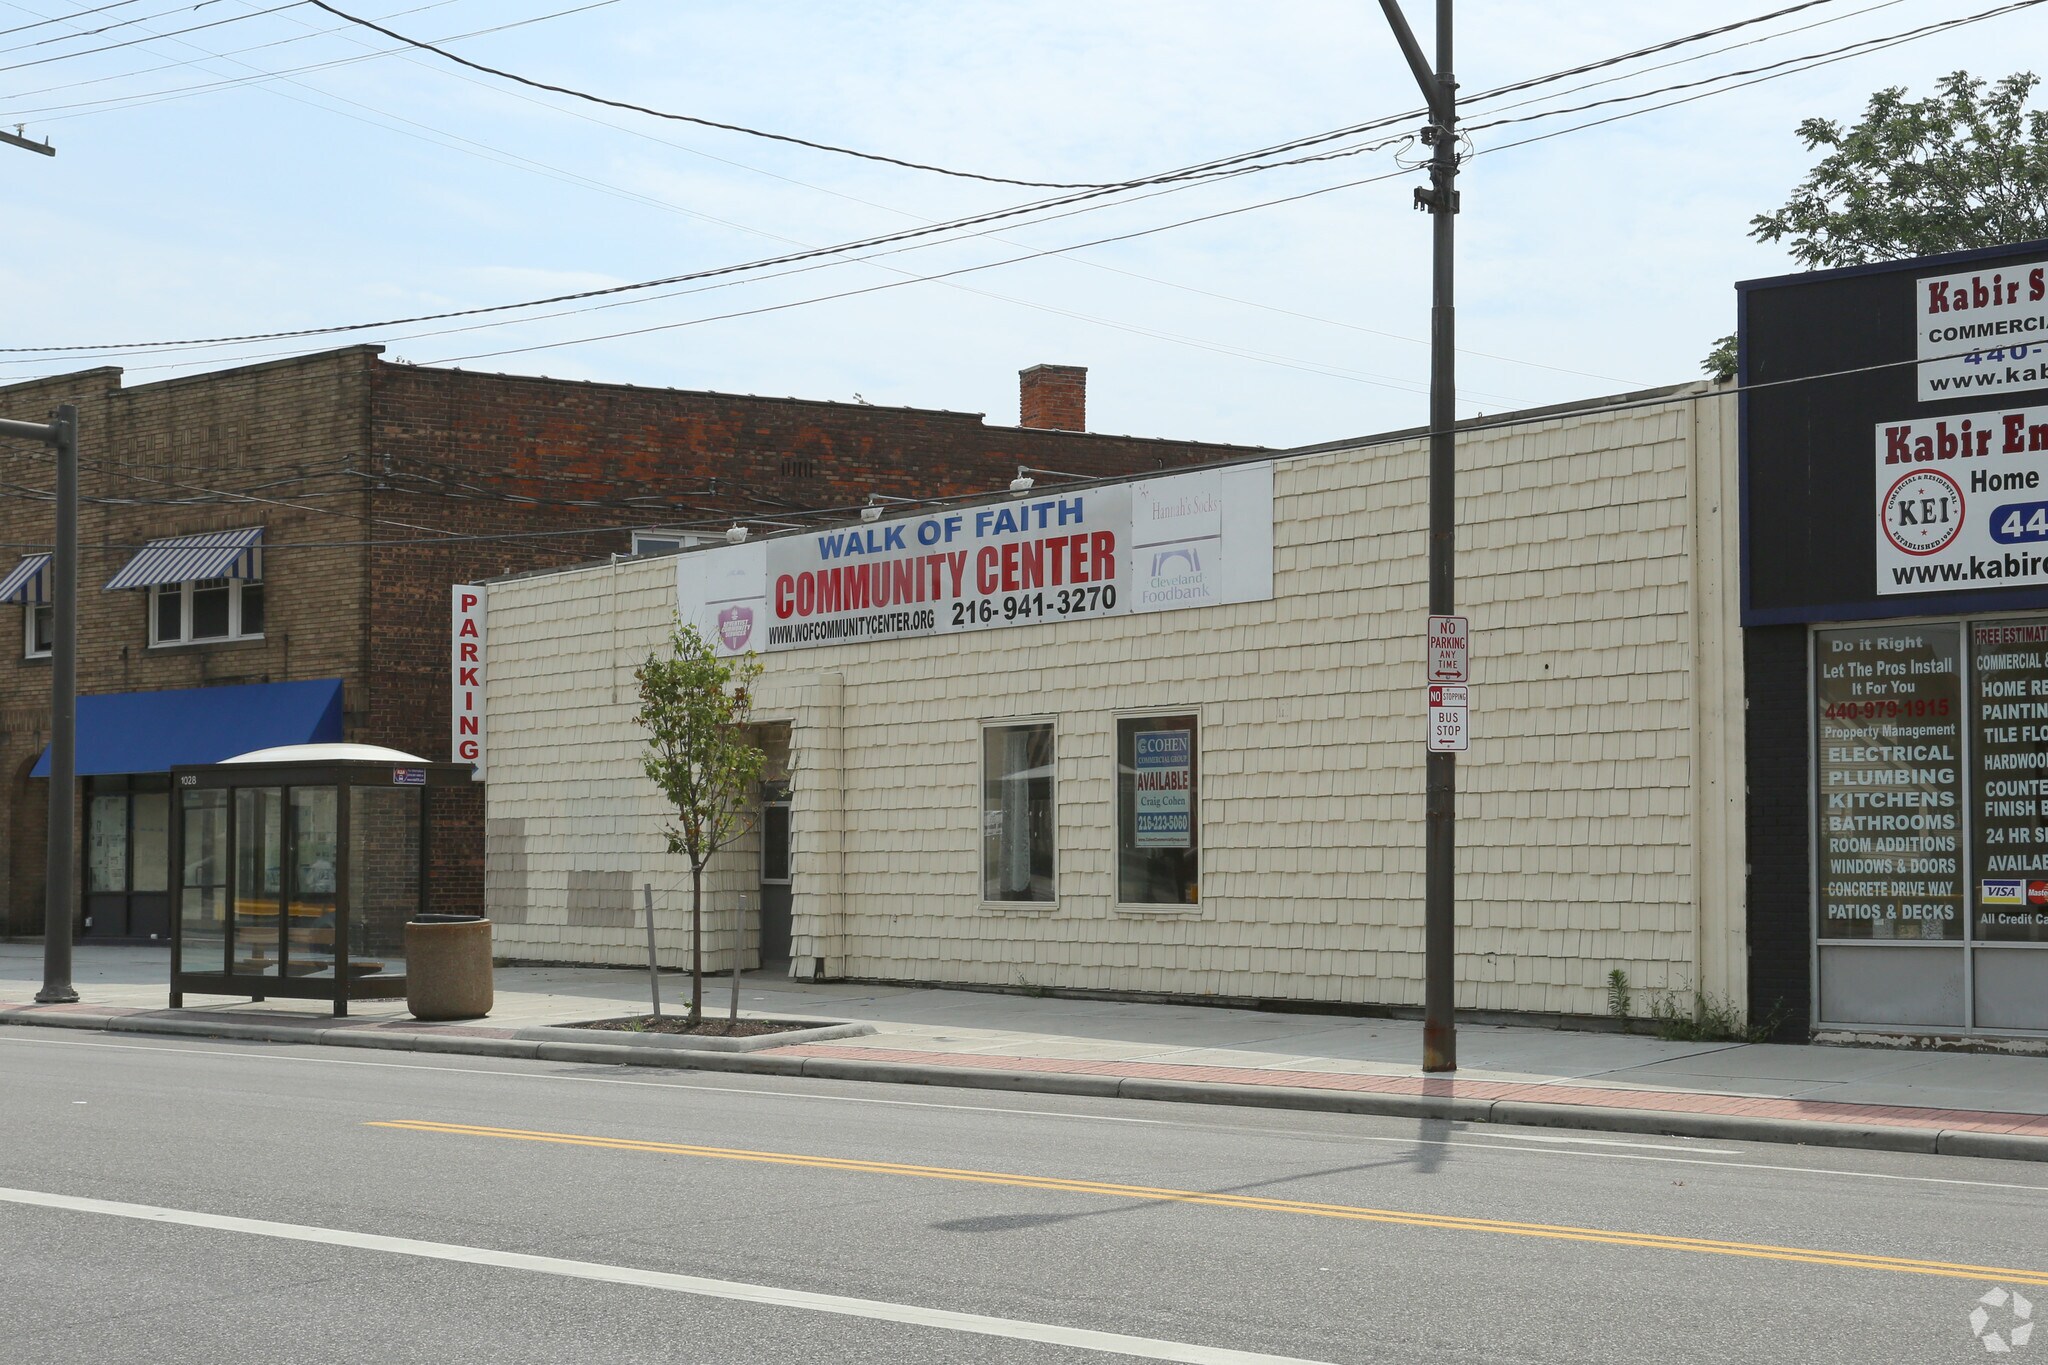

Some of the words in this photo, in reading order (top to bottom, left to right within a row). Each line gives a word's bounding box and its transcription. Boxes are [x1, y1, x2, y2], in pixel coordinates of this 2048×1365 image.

[1928, 274, 2019, 314] Kabir
[2029, 267, 2046, 302] S
[1928, 315, 2048, 343] COMMERCI
[1964, 342, 2042, 365] 440-
[1885, 419, 1992, 465] Kabir
[1971, 469, 2040, 494] Home
[1888, 476, 1917, 510] COMERCIAL
[1923, 474, 1957, 505] RESIDENTIAL
[1898, 497, 1950, 527] KEI
[818, 525, 906, 560] WALK
[917, 516, 962, 546] OF
[975, 497, 1083, 538] FAITH
[1893, 531, 1941, 551] ESTABLISHED
[775, 550, 968, 620] COMMUNITY
[976, 530, 1116, 596] CENTER
[1150, 572, 1203, 589] Cleveland
[1142, 583, 1210, 604] Foodbank
[769, 609, 935, 645] WWW.WOFCOMMUNITYCENTER.ORG
[952, 584, 1117, 626] 216-941-3270
[1440, 622, 1456, 635] NO
[1975, 627, 2001, 644] FREE
[1430, 636, 1465, 650] PARKING
[1832, 640, 1854, 652] Do
[1860, 638, 1872, 651] it
[1877, 636, 1923, 652] Right
[1439, 650, 1456, 659] ANY
[1976, 652, 2042, 671] COMMERCIAL
[1438, 660, 1458, 669] TIME
[1823, 663, 1844, 679] Let
[1848, 662, 1873, 677] The
[1876, 660, 1906, 676] Pros
[1911, 657, 1952, 675] Install
[459, 593, 480, 760] PARKING
[1430, 691, 1441, 702] NO
[1443, 692, 1466, 701] STOPPING
[1852, 682, 1862, 695] It
[1866, 681, 1887, 694] For
[1890, 680, 1915, 694] You
[1981, 680, 2026, 697] HOME
[1438, 712, 1459, 723] BUS
[1825, 699, 1950, 721] 440-979-1915
[1982, 702, 2048, 720] PAINTIN
[1437, 725, 1461, 736] STOP
[1824, 725, 1880, 741] Propperty
[1882, 723, 1955, 739] Management
[1984, 726, 2017, 743] TILE
[1148, 737, 1188, 752] COHEN
[1828, 745, 1954, 763] ELECTRICAL
[1984, 752, 2048, 770] HARDWOO
[181, 775, 197, 785] 1028
[1137, 770, 1188, 791] AVAILABLE
[1828, 768, 1955, 786] PLUMBING
[1985, 779, 2048, 797] COUNTE
[1140, 796, 1161, 808] Craig
[1162, 795, 1186, 806] Cohen
[1828, 791, 1955, 809] KITCHENS
[1985, 800, 2036, 817] FINISH
[1829, 814, 1955, 831] BATHROOMS
[1829, 837, 1871, 853] ROOM
[1875, 835, 1955, 852] ADDITIONS
[1986, 827, 2004, 844] 24
[2008, 827, 2030, 843] HR
[1830, 858, 1892, 874] WINDOWS
[1896, 858, 1906, 874] &
[1910, 857, 1956, 874] DOORS
[1828, 881, 1888, 897] CONCRETE
[1891, 881, 1926, 897] DRIVE
[1928, 881, 1953, 896] WAY
[1988, 886, 2016, 897] VISA
[1828, 904, 1880, 920] PATIOS
[1886, 904, 1897, 920] &
[1902, 903, 1954, 920] DECKS
[1980, 913, 1995, 924] All
[1998, 913, 2032, 925] Credit
